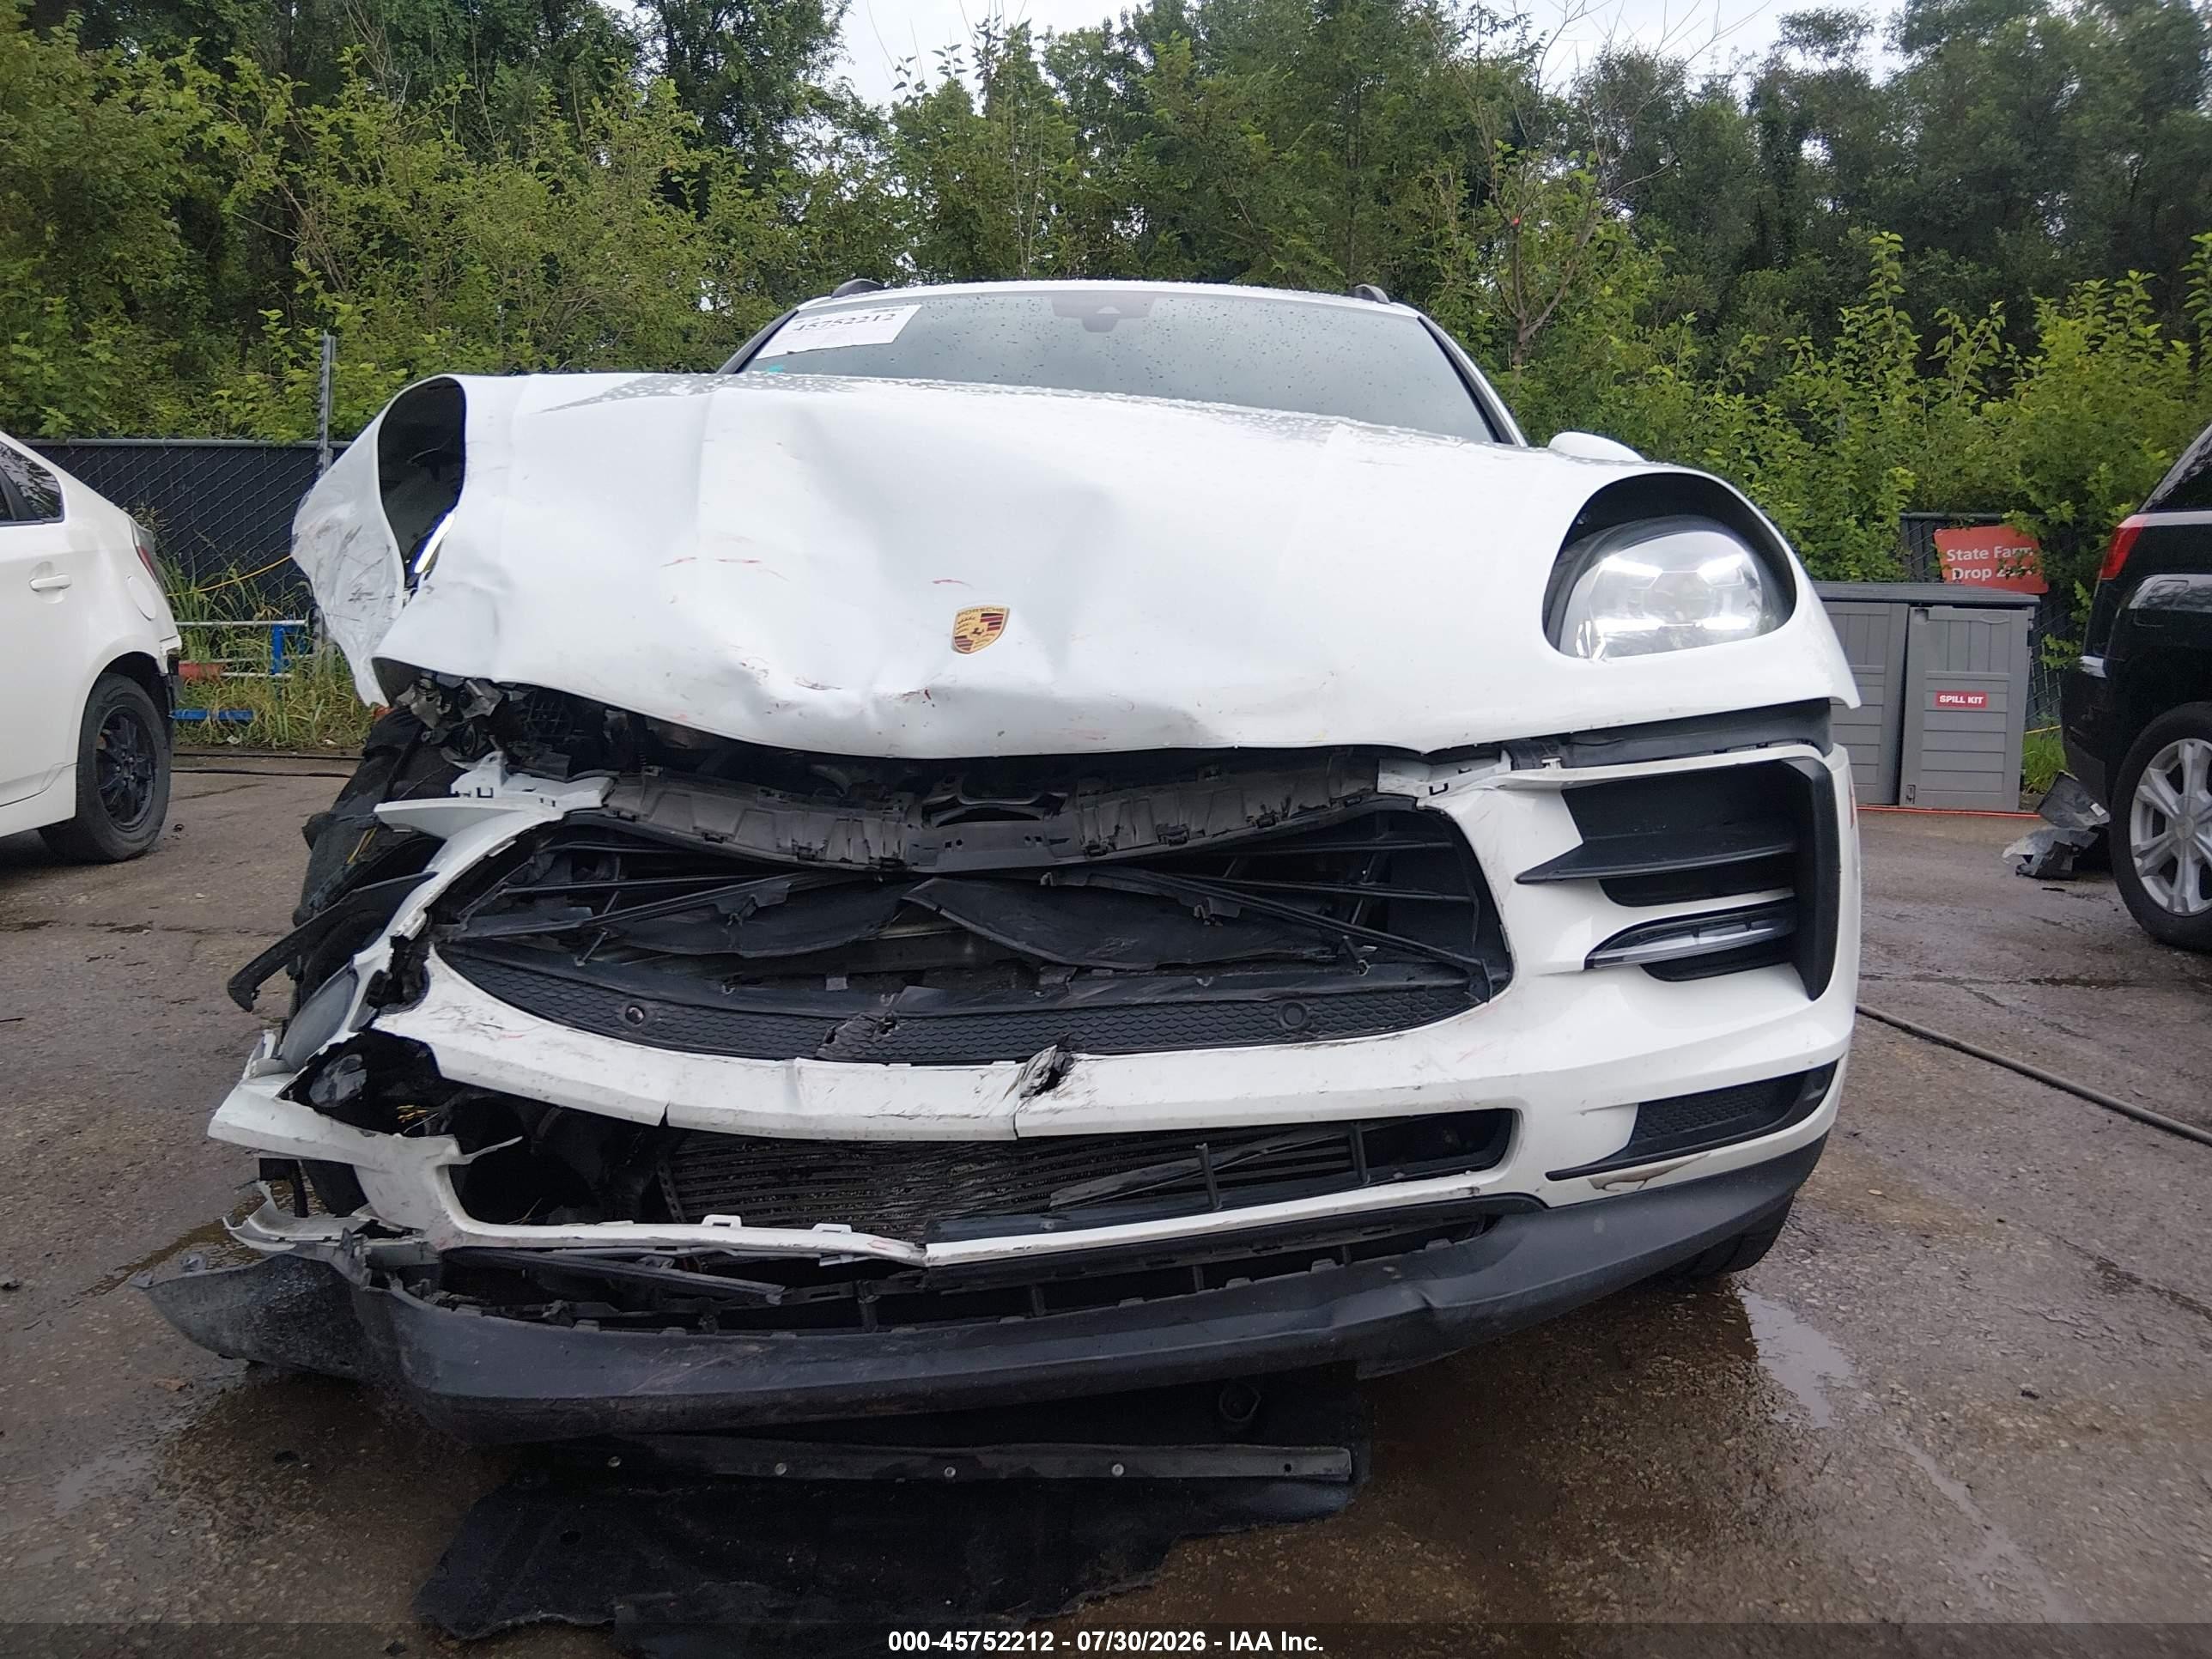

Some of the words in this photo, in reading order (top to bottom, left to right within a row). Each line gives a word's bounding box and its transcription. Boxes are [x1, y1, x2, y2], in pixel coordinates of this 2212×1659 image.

[1946, 548, 1990, 562] State
[1951, 567, 1992, 582] Drop
[1939, 695, 1966, 703] SPILL
[1967, 696, 1984, 704] KIT
